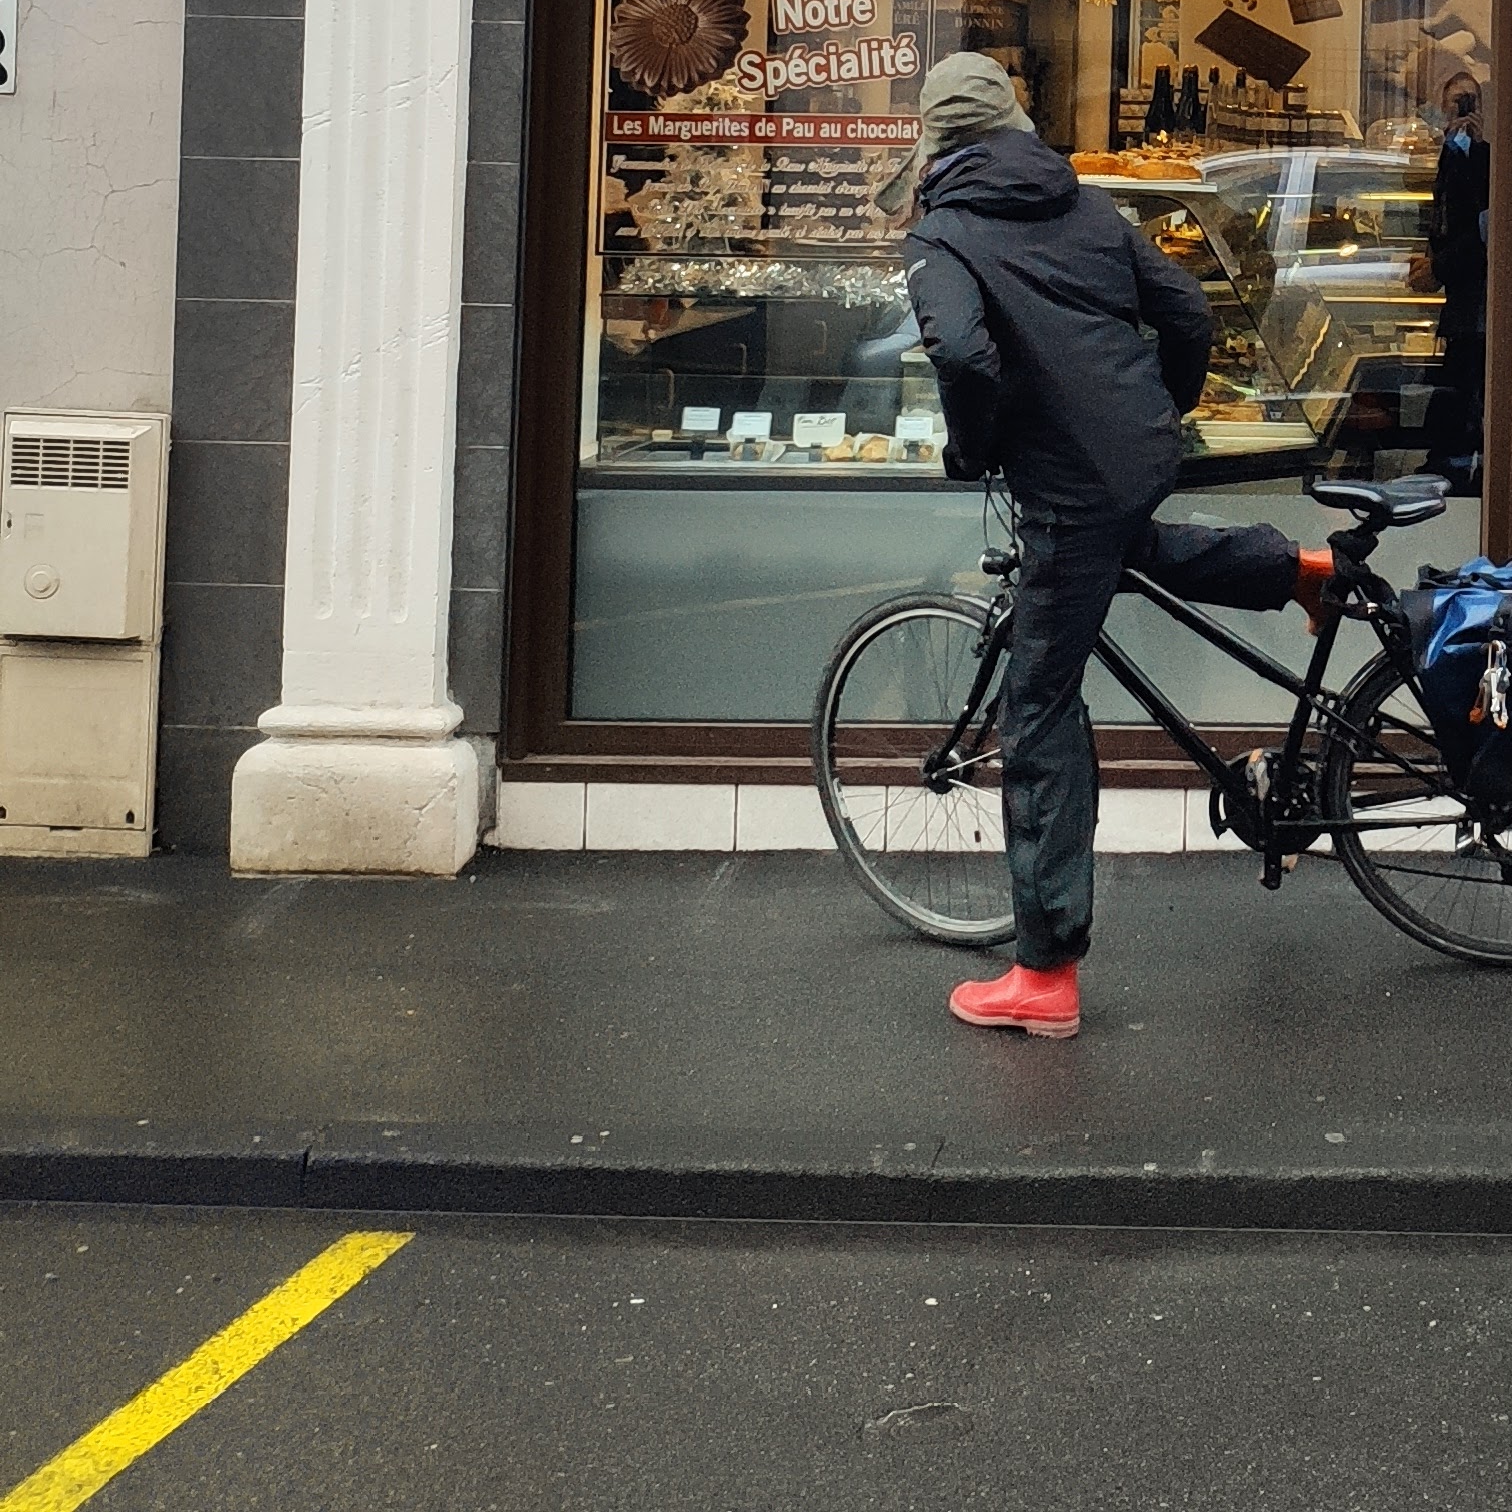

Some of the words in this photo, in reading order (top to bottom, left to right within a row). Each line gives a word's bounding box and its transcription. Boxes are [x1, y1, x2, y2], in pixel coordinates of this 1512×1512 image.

[736, 33, 919, 99] Spécialité
[612, 115, 643, 135] Les
[648, 115, 750, 140] Marguerites
[755, 117, 777, 137] de
[782, 118, 815, 138] Pau
[819, 123, 843, 138] au
[846, 118, 919, 140] chocolat
